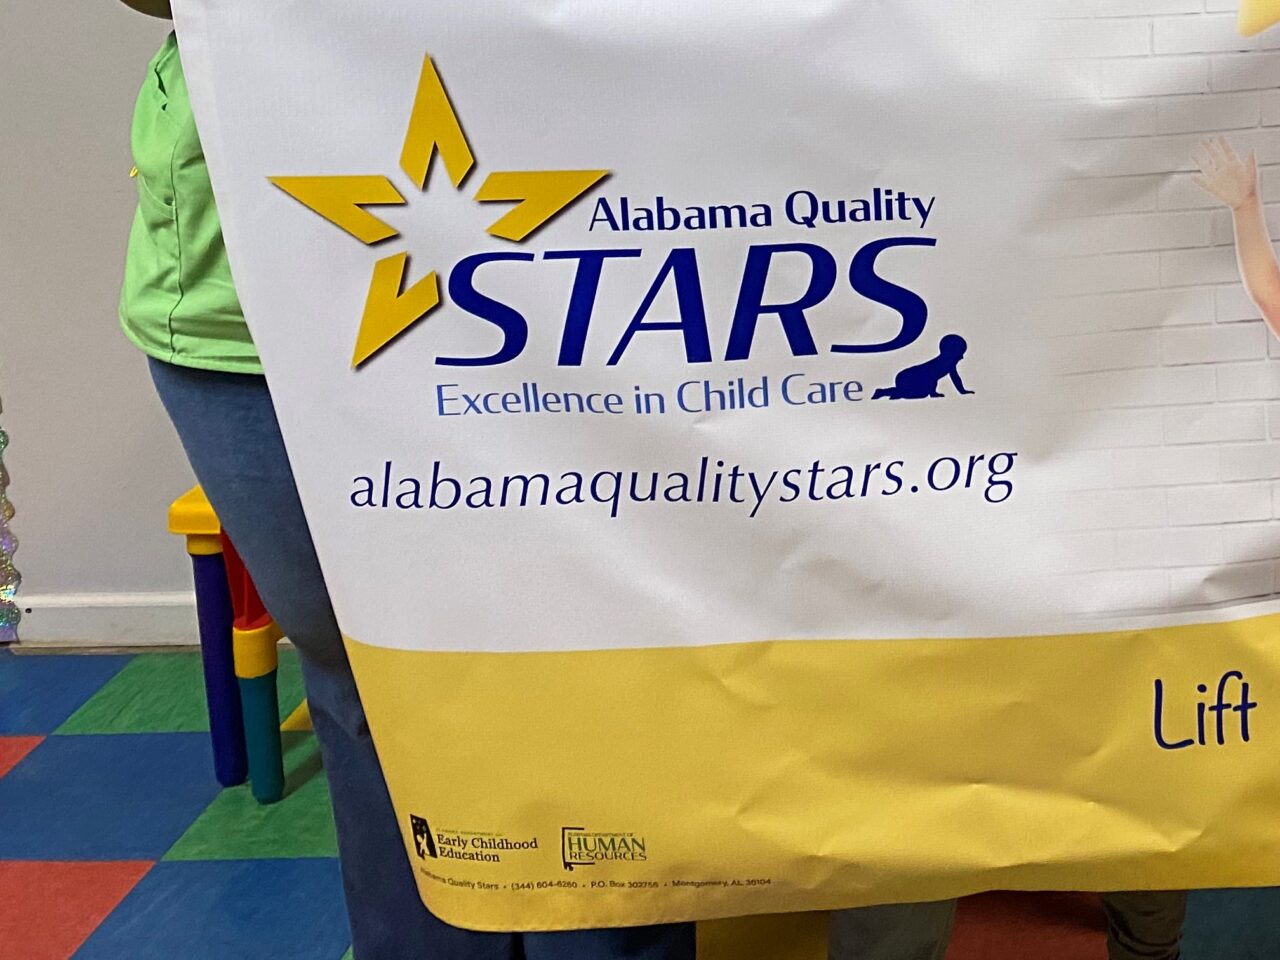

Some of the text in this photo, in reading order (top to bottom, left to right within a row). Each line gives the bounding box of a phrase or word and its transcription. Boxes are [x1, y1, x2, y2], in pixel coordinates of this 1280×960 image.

[589, 188, 936, 232] Alabama Quality
[434, 236, 937, 367] STARS
[436, 374, 864, 416] Excellence in Child Care
[350, 449, 1018, 518] alabamaqualitystars.org
[1152, 672, 1258, 750] Lift
[437, 834, 538, 850] Early Childhood
[438, 847, 500, 862] Education
[568, 836, 646, 851] HUMAN
[569, 851, 647, 861] RESOURCES
[447, 878, 475, 890] Quality
[477, 881, 499, 890] Stars
[609, 880, 625, 888] Box
